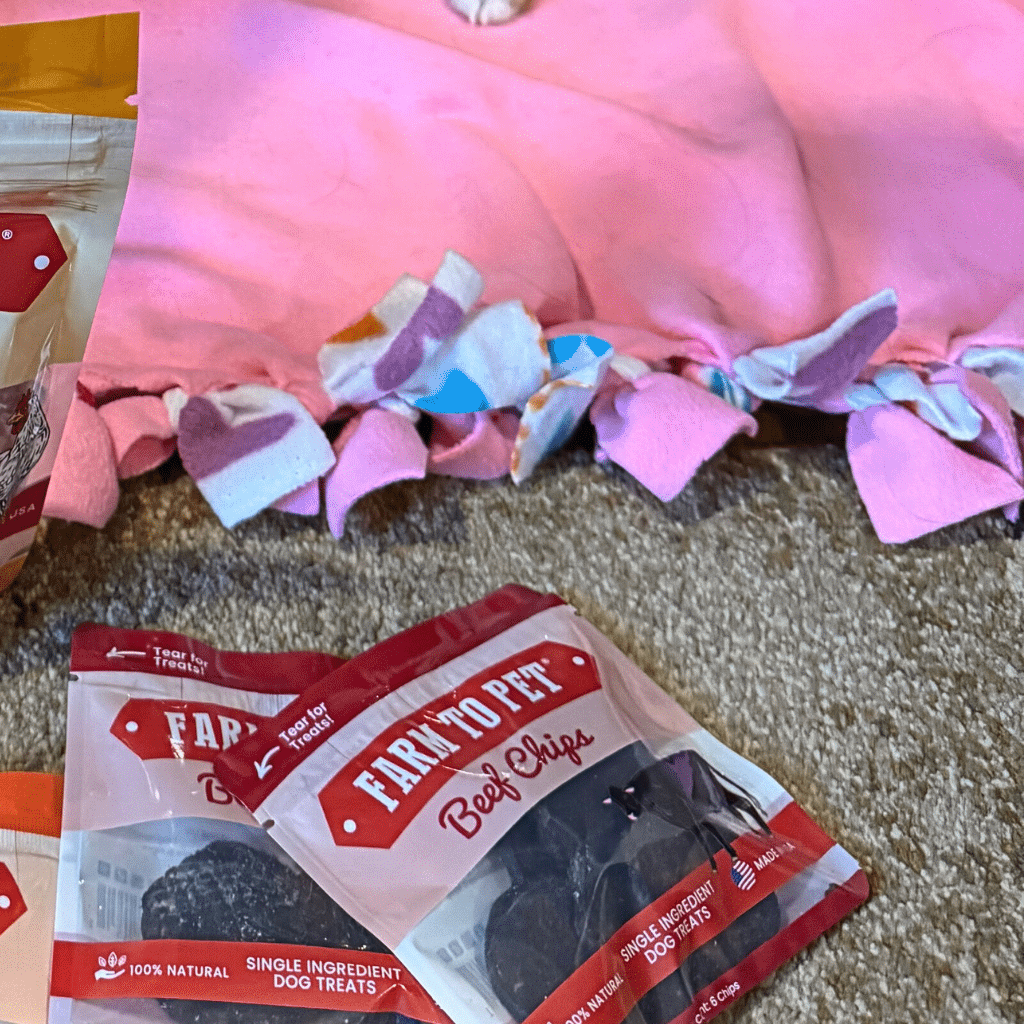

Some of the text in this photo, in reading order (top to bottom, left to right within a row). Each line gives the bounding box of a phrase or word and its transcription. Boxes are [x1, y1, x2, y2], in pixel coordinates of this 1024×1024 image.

[152, 647, 209, 668] Tear for
[152, 656, 205, 676] Treats!
[164, 711, 258, 751] FAR
[278, 701, 328, 743] Tear for
[289, 714, 335, 751] Treats!
[352, 722, 462, 813] FARM
[437, 696, 502, 739] TO
[438, 728, 596, 840] Beef Chips
[619, 879, 716, 964] SINGLE INGREDIENT
[644, 905, 712, 965] DOG TREATS
[129, 962, 230, 979] 100% NATURAL
[246, 955, 402, 981] SINGLE INGREDIENT
[274, 973, 377, 996] DOG TREATS
[586, 972, 624, 1012] NATURAL
[709, 995, 719, 1007] 6
[716, 980, 741, 1003] Chips
